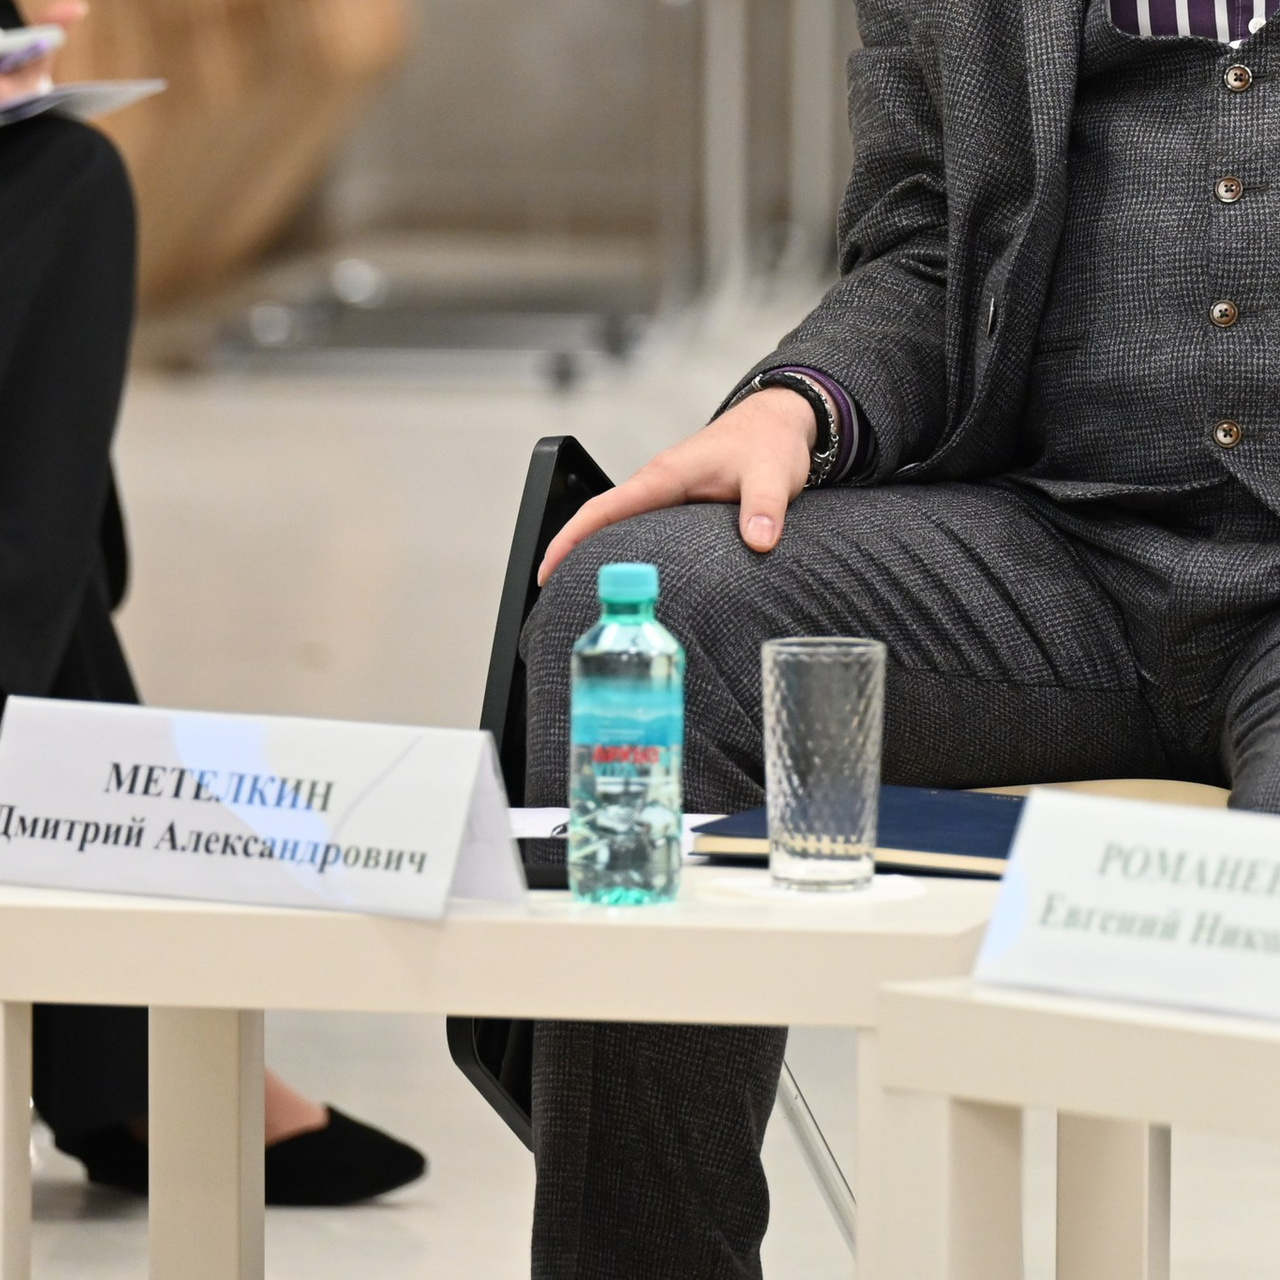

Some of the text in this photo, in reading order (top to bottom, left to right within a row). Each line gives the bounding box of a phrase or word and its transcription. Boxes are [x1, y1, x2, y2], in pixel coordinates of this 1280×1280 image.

[103, 761, 335, 813] МЕТЕЛКИН
[0, 803, 429, 875] Дмитрий Александрович
[1038, 890, 1182, 943] Евгений
